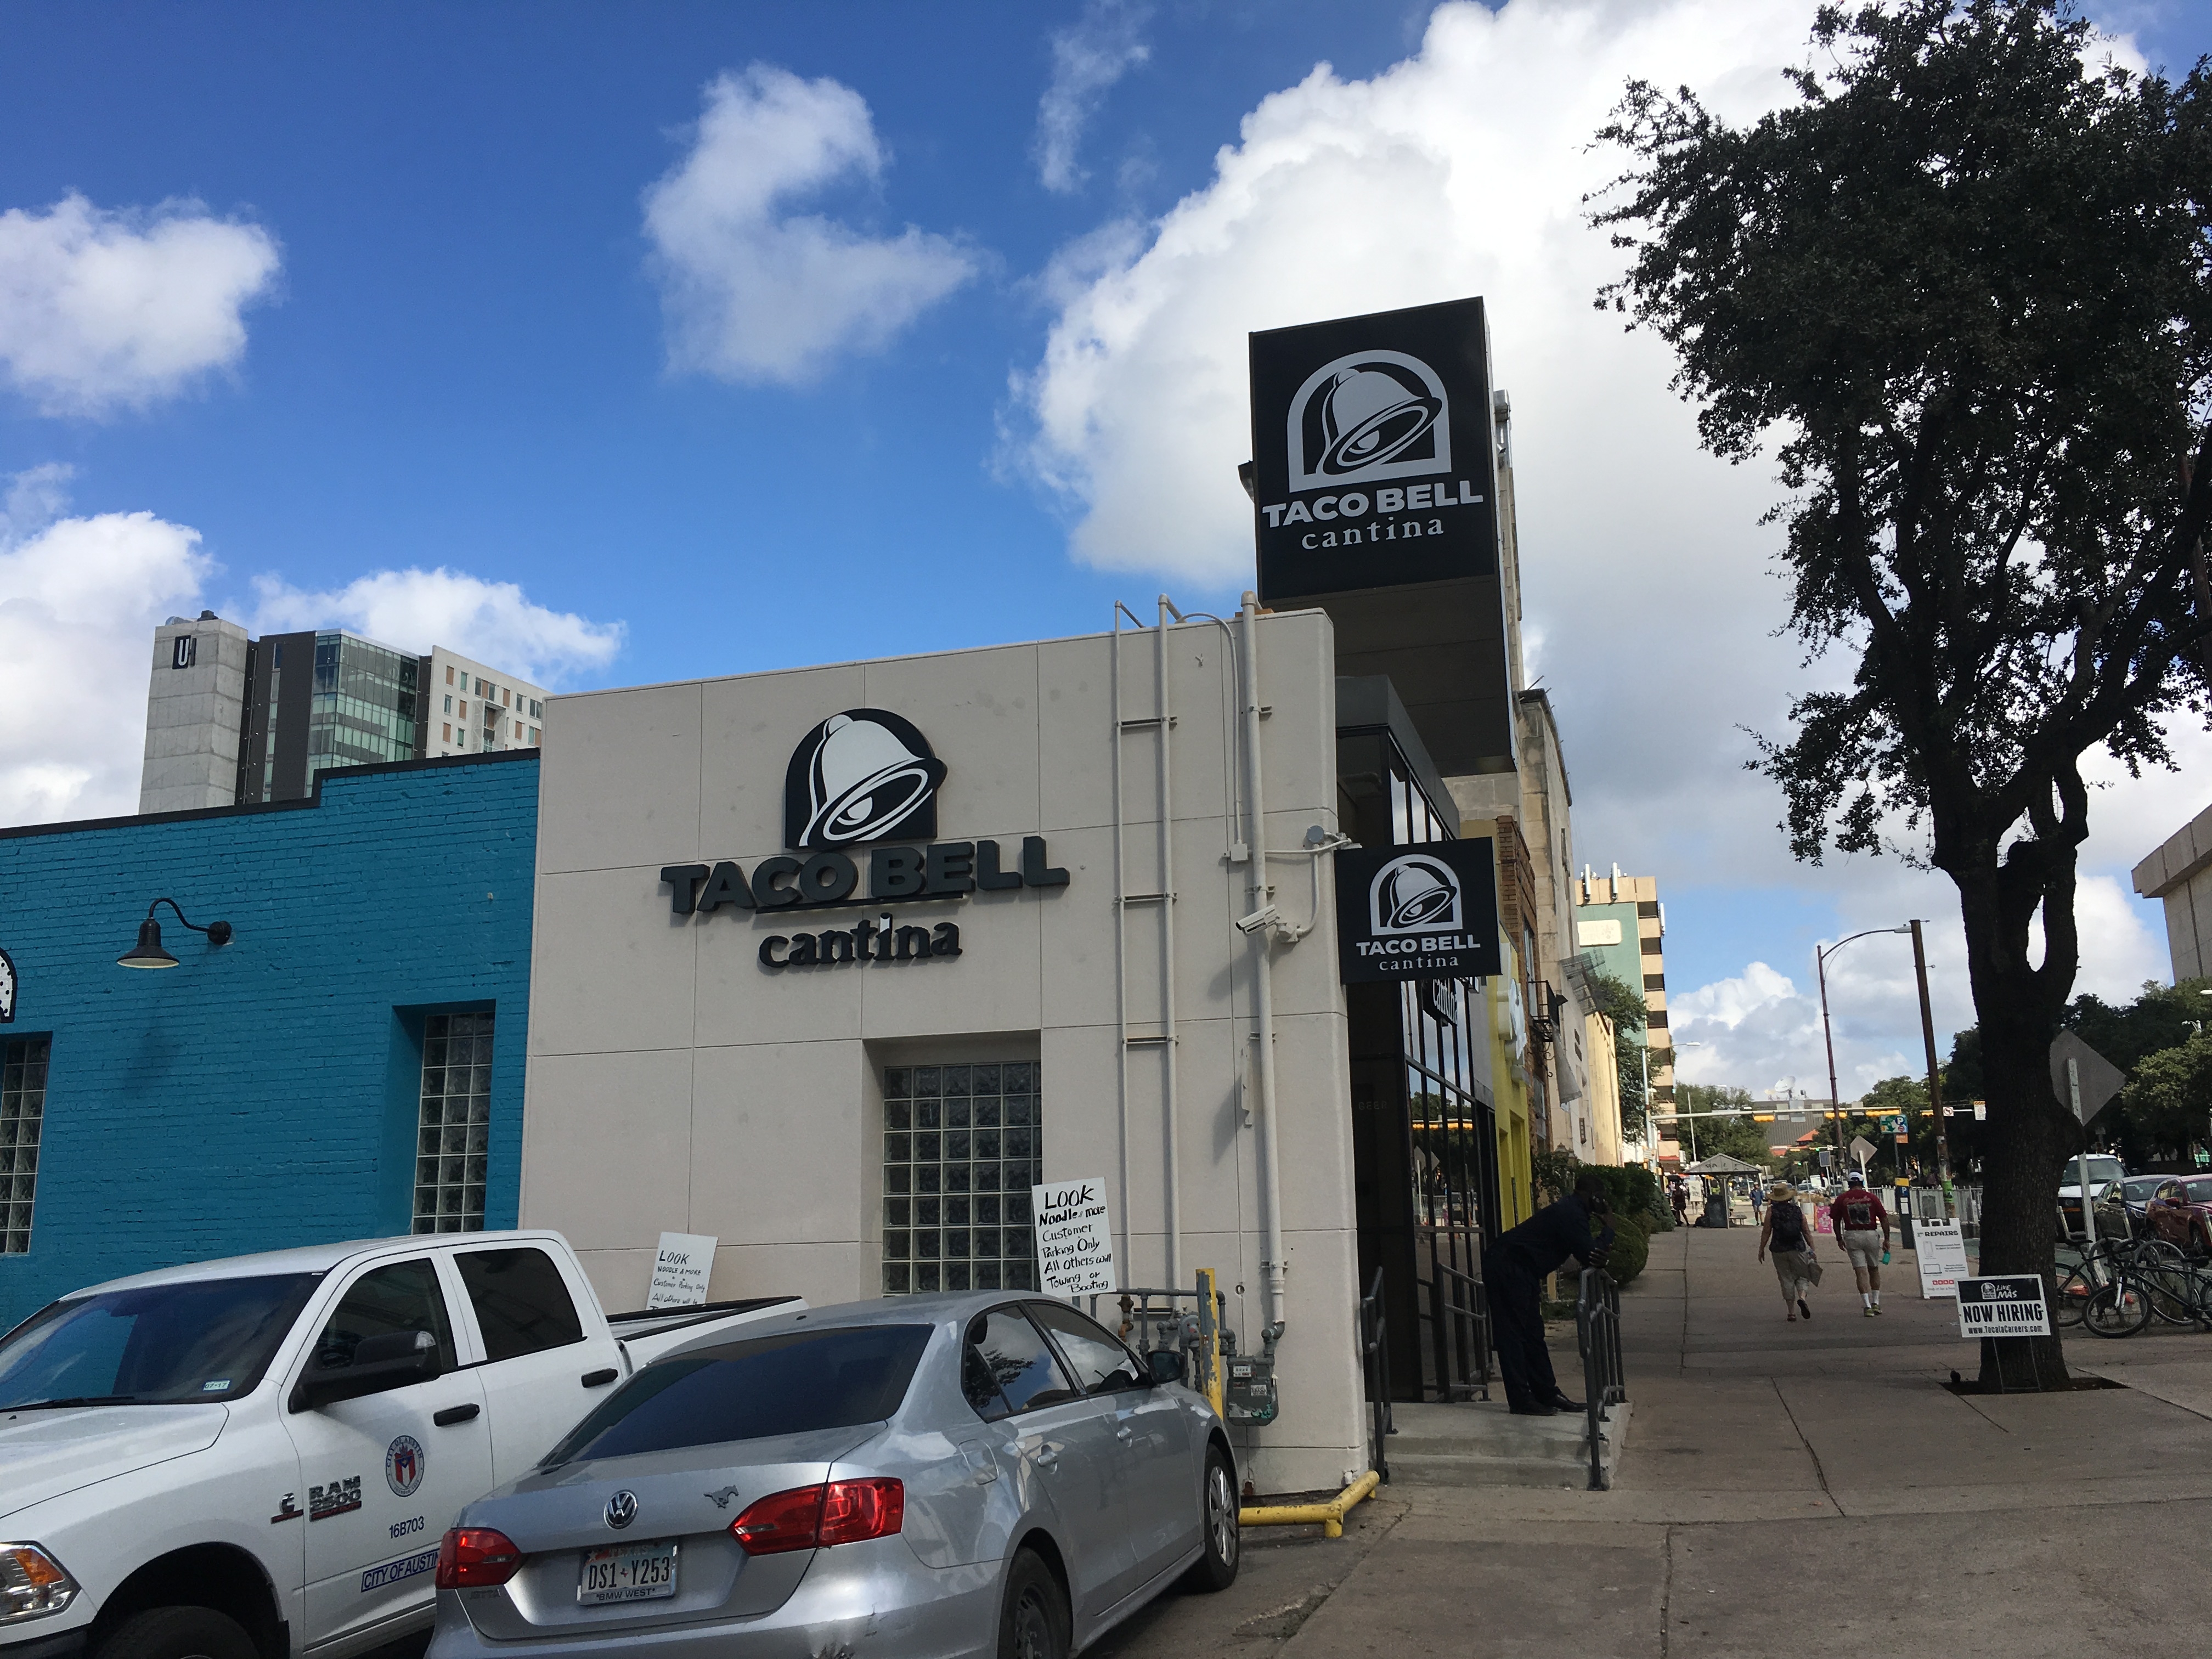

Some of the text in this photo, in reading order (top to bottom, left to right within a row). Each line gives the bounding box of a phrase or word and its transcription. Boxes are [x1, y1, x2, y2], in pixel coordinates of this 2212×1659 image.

[1262, 481, 1483, 528] TACO BELL
[1302, 516, 1444, 550] cantina
[661, 836, 1070, 914] TACO BELL
[758, 913, 963, 968] cantina
[1356, 934, 1481, 956] TACO BELL
[1379, 954, 1459, 970] cantina
[1045, 1184, 1094, 1209] LOOK
[1039, 1209, 1077, 1227] Noodle
[1085, 1206, 1105, 1217] more
[1042, 1223, 1093, 1242] Customer
[659, 1250, 690, 1265] LOOK
[1041, 1237, 1100, 1258] Parking Only
[1044, 1260, 1059, 1274] All
[653, 1278, 676, 1288] Customer
[1046, 1273, 1080, 1289] Towing
[1067, 1280, 1108, 1293] Booting
[652, 1293, 664, 1301] All
[1963, 1304, 2044, 1323] NOW HIRING
[309, 1475, 360, 1500] RAM
[389, 1515, 424, 1539] 16B703
[364, 1567, 388, 1588] CITY
[390, 1562, 404, 1579] OF
[588, 1556, 670, 1590] DS1 Y253
